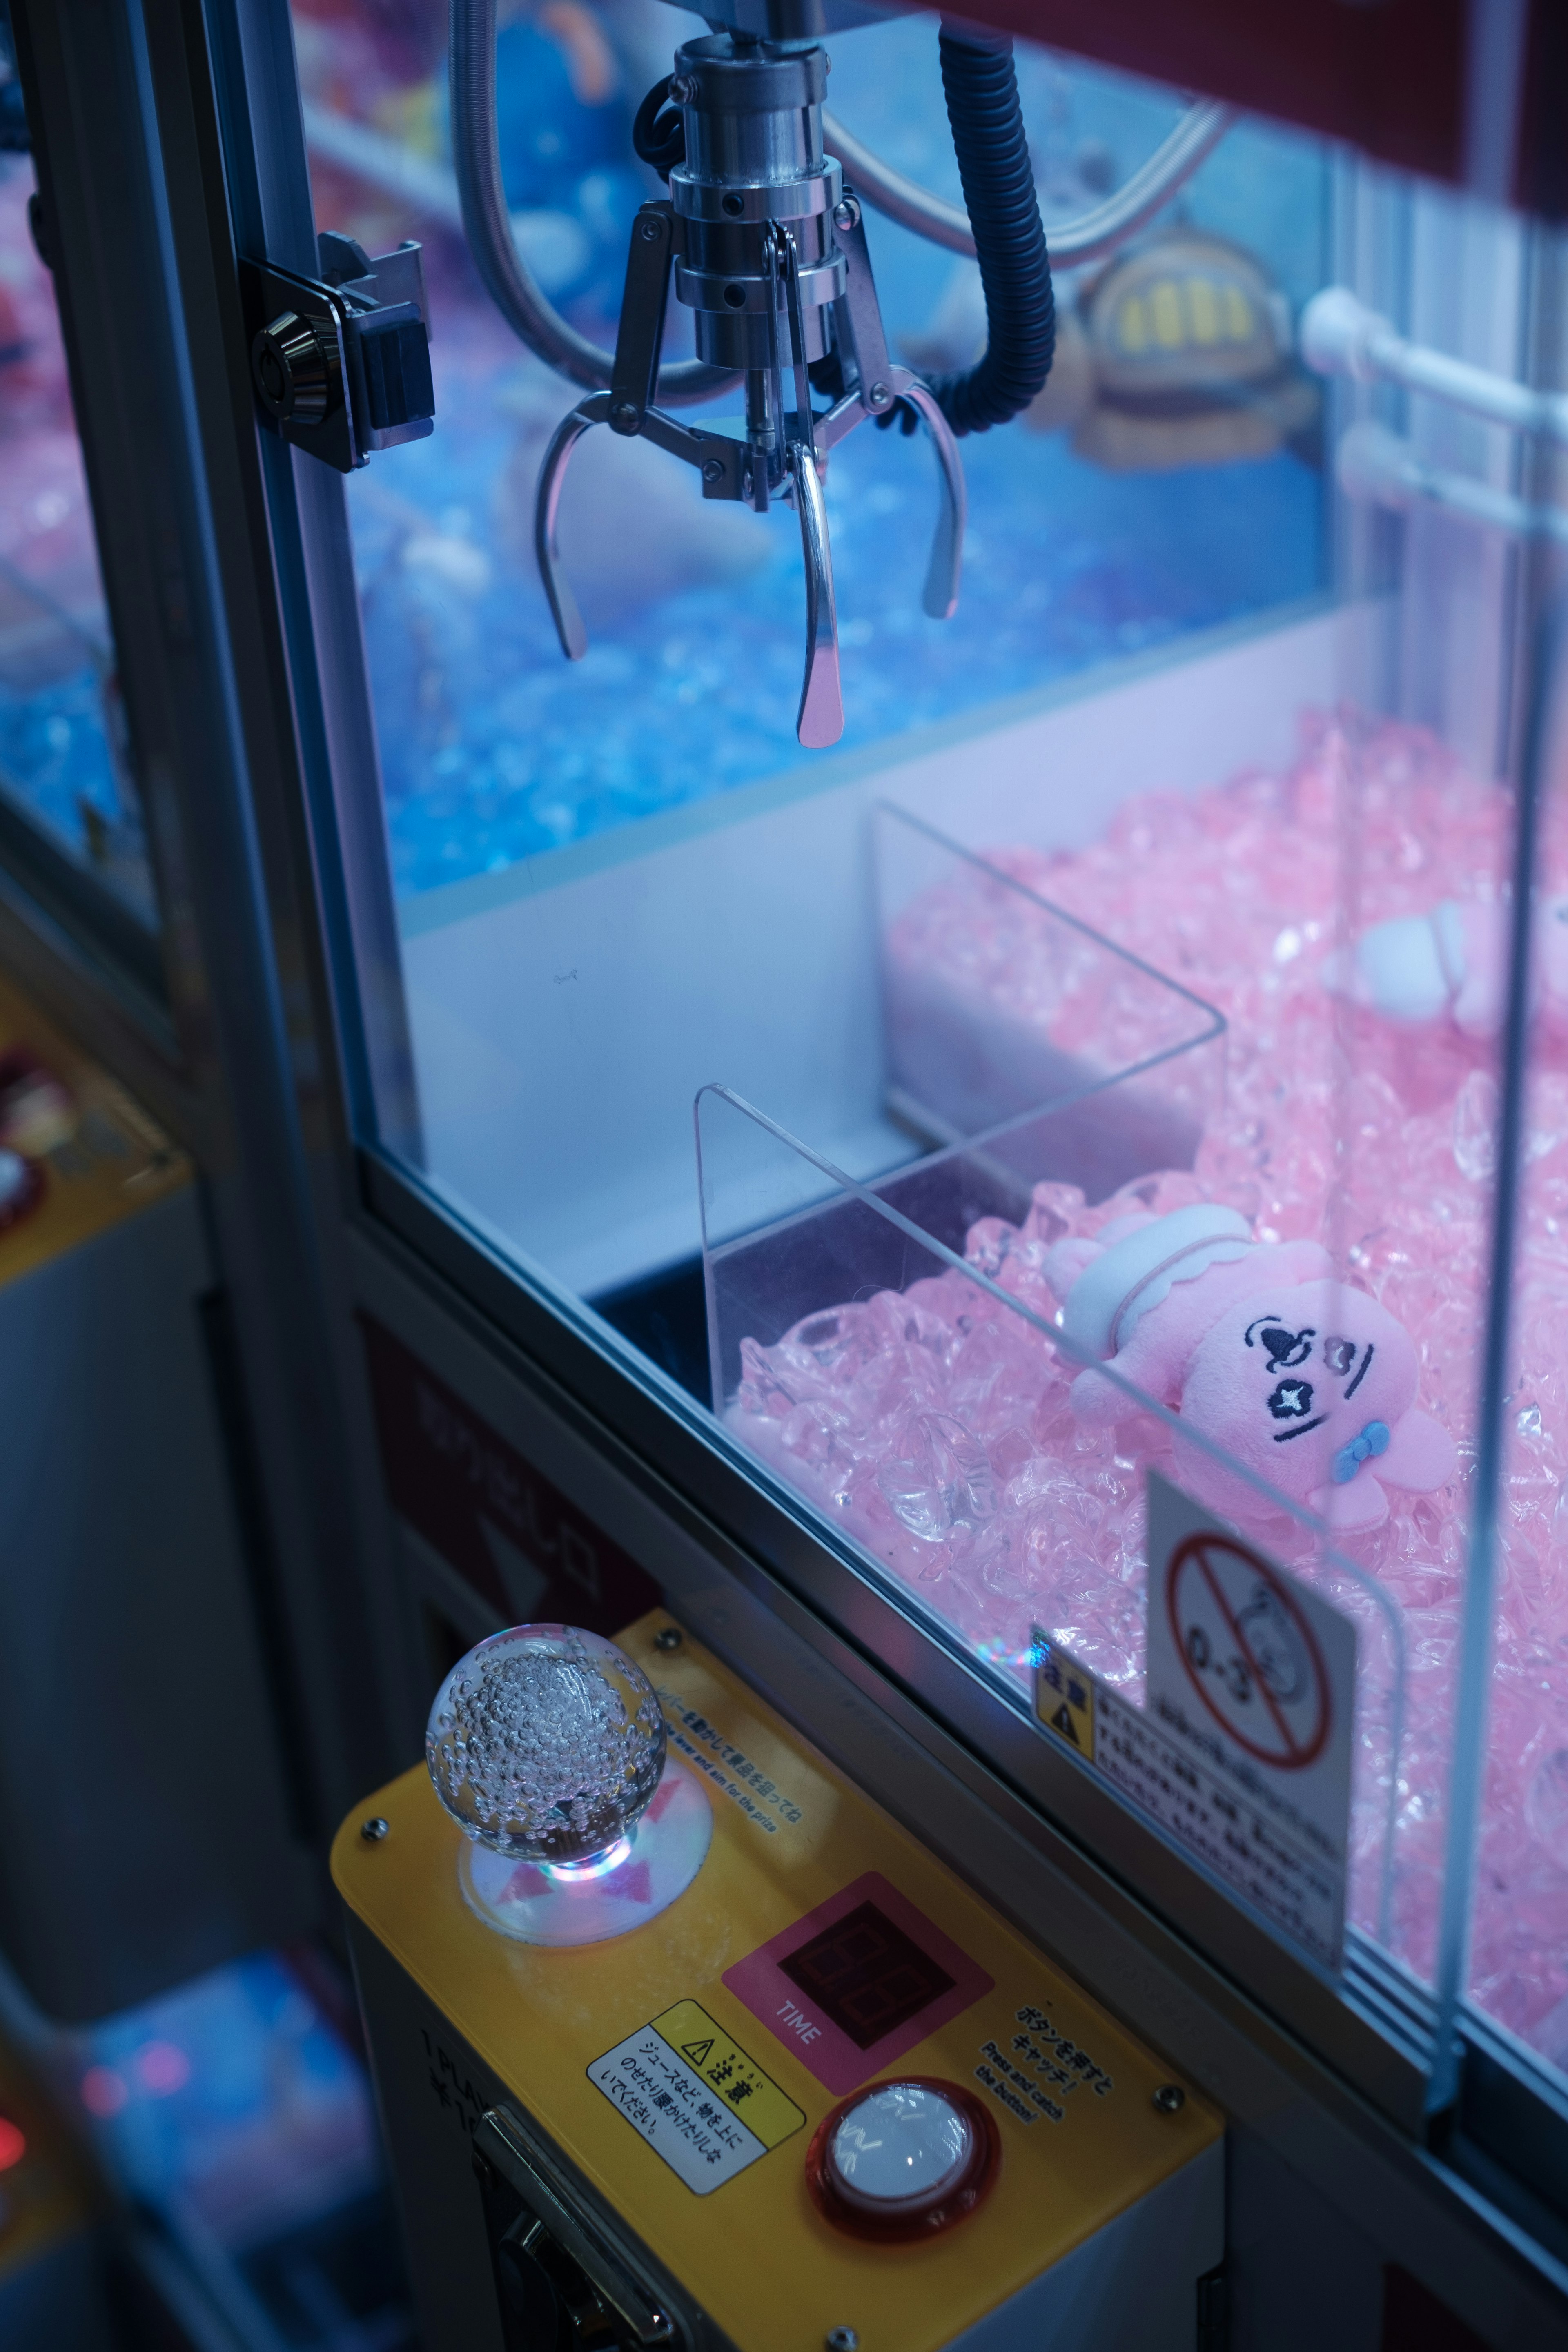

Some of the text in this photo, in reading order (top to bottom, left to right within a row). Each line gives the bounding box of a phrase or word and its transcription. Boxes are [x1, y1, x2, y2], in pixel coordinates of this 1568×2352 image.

[674, 1733, 696, 1755] lever
[694, 1755, 714, 1771] and
[709, 1770, 727, 1786] aim
[725, 1783, 742, 1797] for
[738, 1796, 755, 1812] the
[750, 1811, 777, 1833] prize
[776, 2000, 822, 2045] TIME
[1016, 2007, 1113, 2096] ボタンを押すと
[601, 2069, 657, 2135] いでください。
[620, 2057, 721, 2164] のせたり腰かけたりしな
[639, 2042, 743, 2150] ジュースなど、物を上に
[707, 2059, 753, 2104] 注意
[975, 2065, 1039, 2123] the button!
[980, 2041, 1064, 2122] Press and catch
